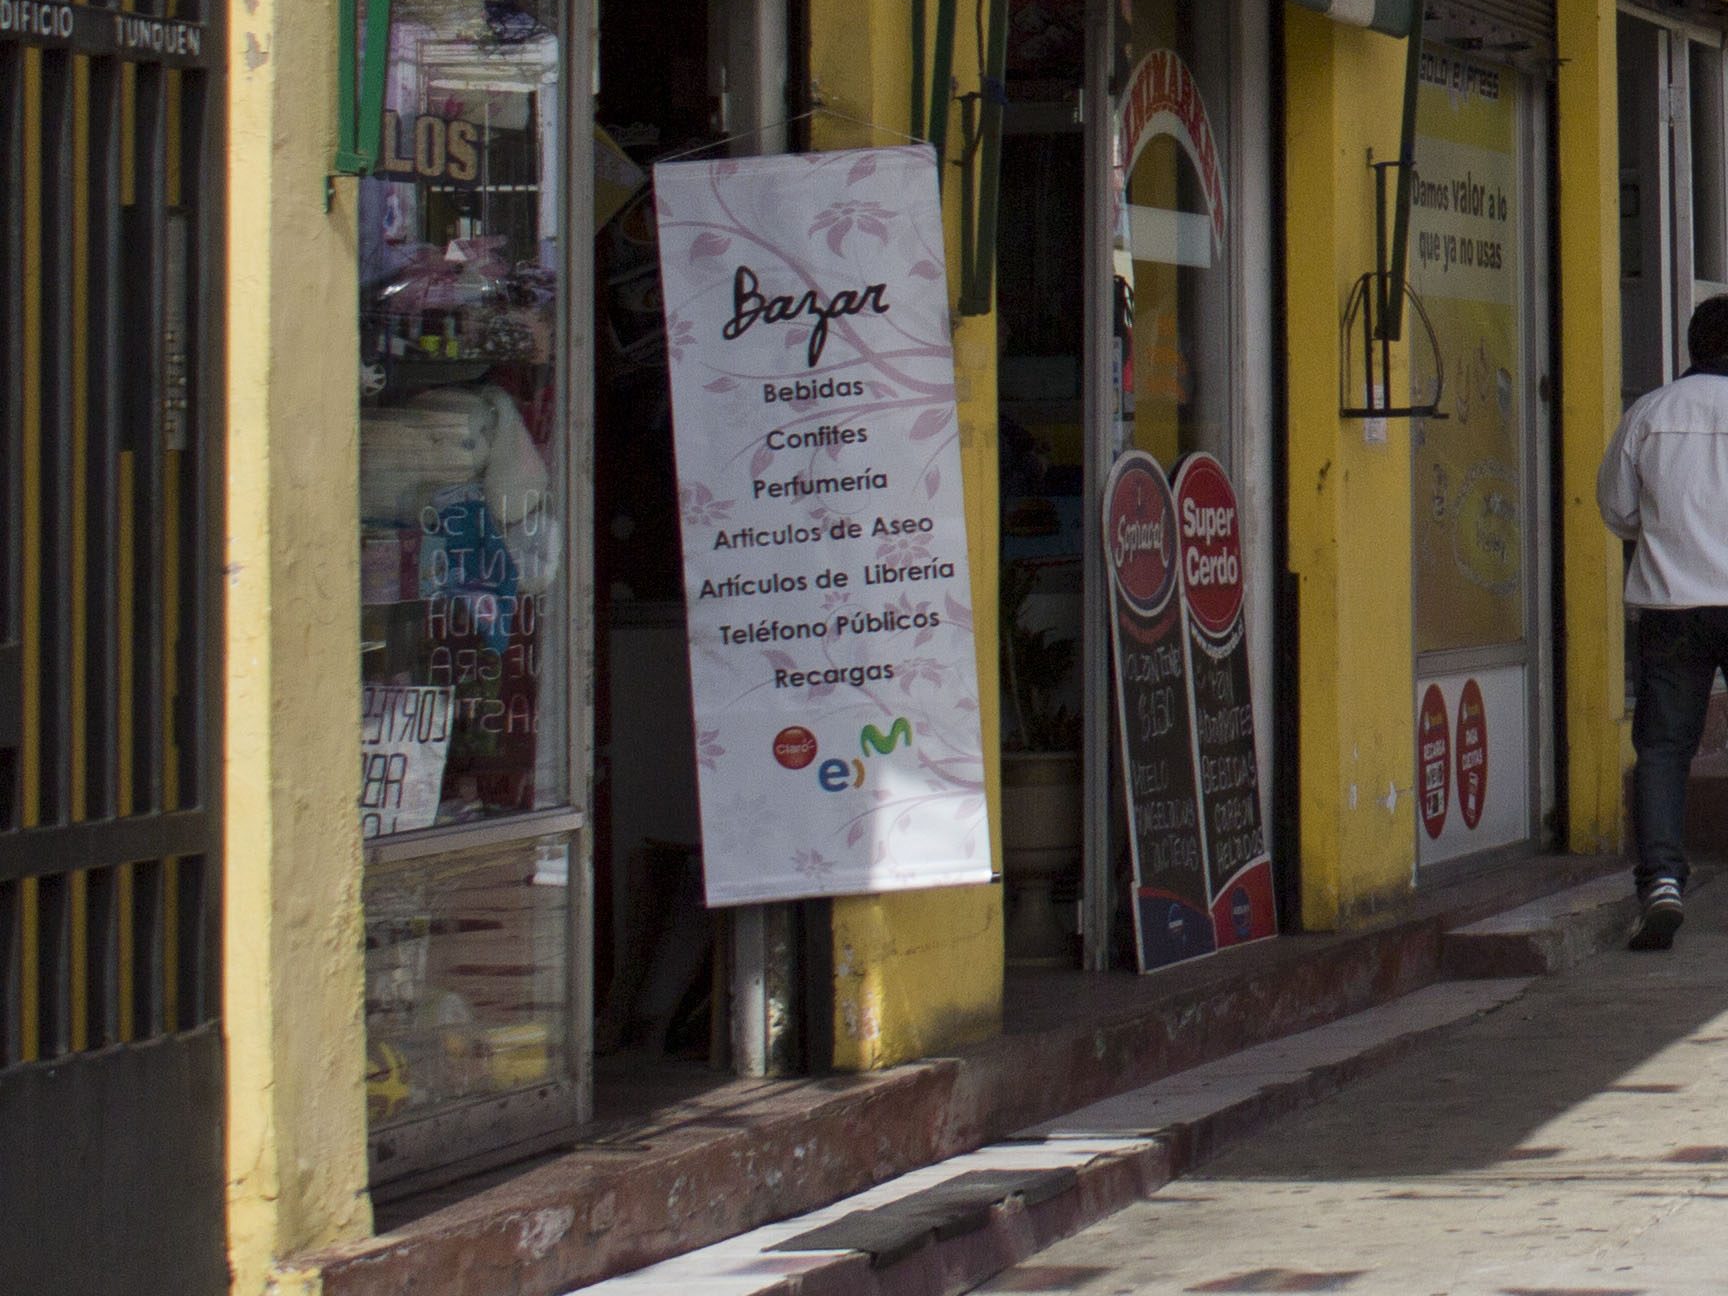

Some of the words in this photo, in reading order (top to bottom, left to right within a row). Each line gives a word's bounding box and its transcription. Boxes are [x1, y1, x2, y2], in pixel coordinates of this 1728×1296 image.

[383, 110, 479, 182] LOS
[1412, 169, 1449, 211] Damos
[1452, 171, 1486, 218] valor
[1488, 192, 1495, 220] a
[1496, 187, 1508, 223] lo
[1419, 230, 1441, 270] que
[1443, 234, 1457, 273] ya
[1459, 237, 1474, 266] no
[1476, 240, 1502, 270] usas
[723, 265, 891, 368] Bazar
[763, 377, 865, 404] Bebidas
[766, 424, 869, 452] Confites
[753, 469, 889, 501] Perfumería
[829, 517, 863, 541] de
[871, 514, 935, 537] Aseo
[1115, 507, 1170, 569] Sopraval
[1183, 496, 1235, 547] Super
[698, 570, 809, 601] Artículos
[815, 566, 850, 591] de
[864, 558, 957, 587] Librería
[1186, 545, 1239, 587] Cerdo
[720, 616, 829, 646] Teléfono
[836, 607, 941, 637] Públicos
[775, 658, 895, 691] Recargas
